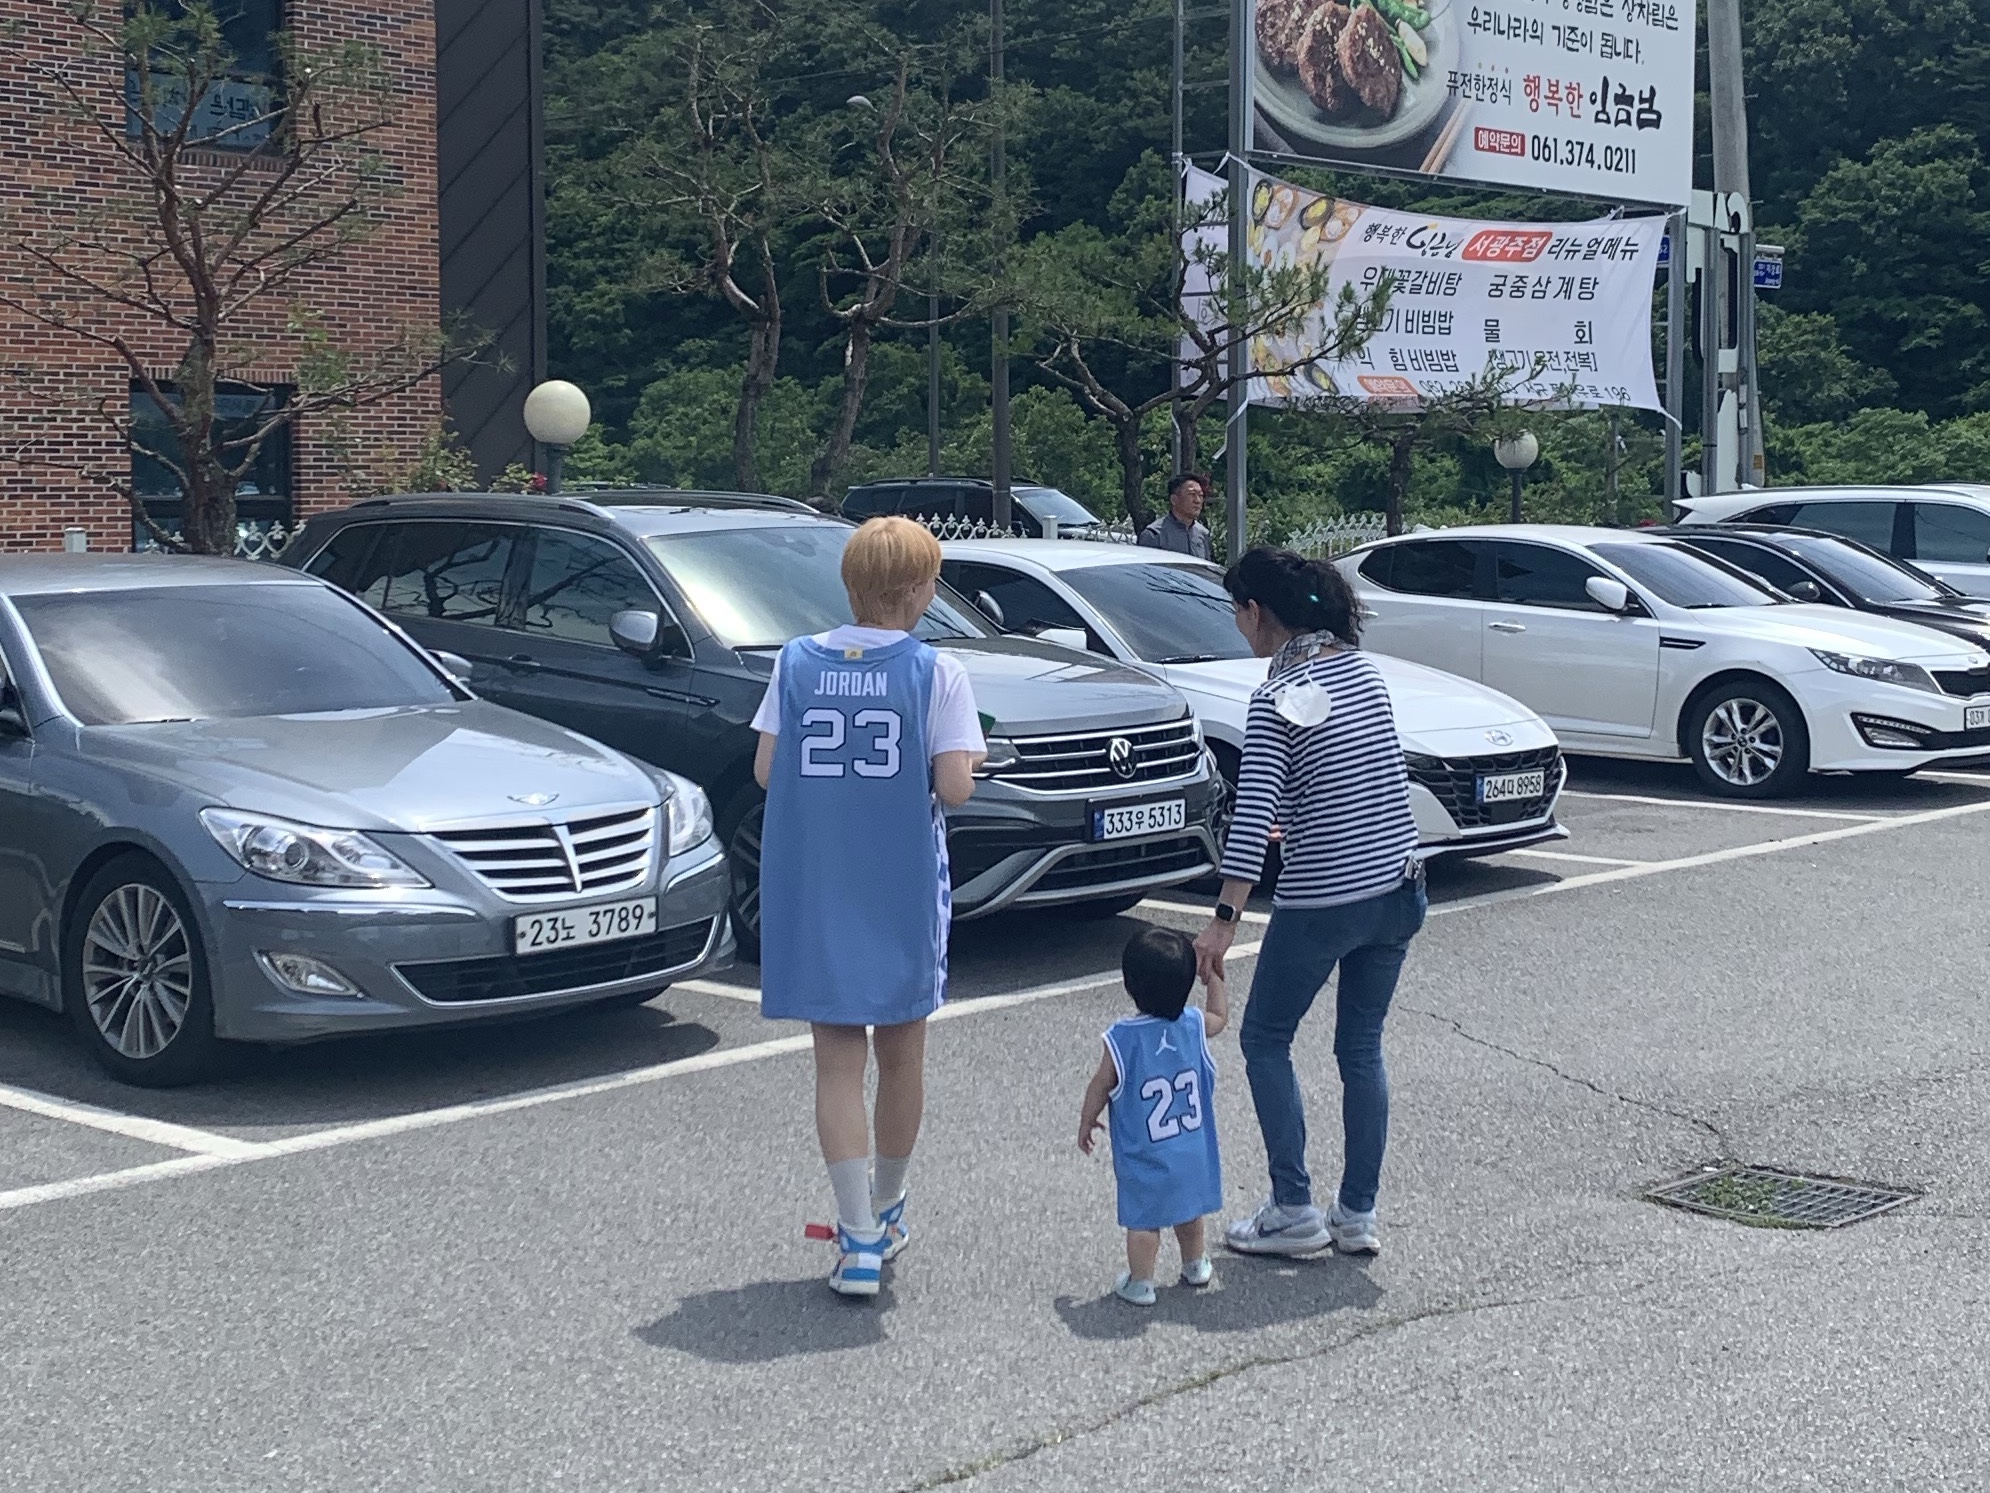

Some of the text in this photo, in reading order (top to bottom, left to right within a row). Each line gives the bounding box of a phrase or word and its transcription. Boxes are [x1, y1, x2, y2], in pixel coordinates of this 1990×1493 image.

[1467, 6, 1544, 45] 우리나라의
[1552, 25, 1593, 54] 기준이
[1621, 0, 1679, 31] 상차림은
[1446, 70, 1663, 131] 퓨전한정식 행복한 임금님
[1478, 129, 1636, 174] 예약문의 061.374.0211
[1364, 222, 1408, 245] 행복한
[1469, 234, 1547, 258] 서광주점
[814, 671, 887, 697] JORDAN
[800, 707, 903, 778] 23
[1106, 810, 1145, 835] 333우
[1148, 804, 1182, 829] 5313
[530, 904, 645, 947] 23노 3789
[1140, 1067, 1202, 1143] 23
